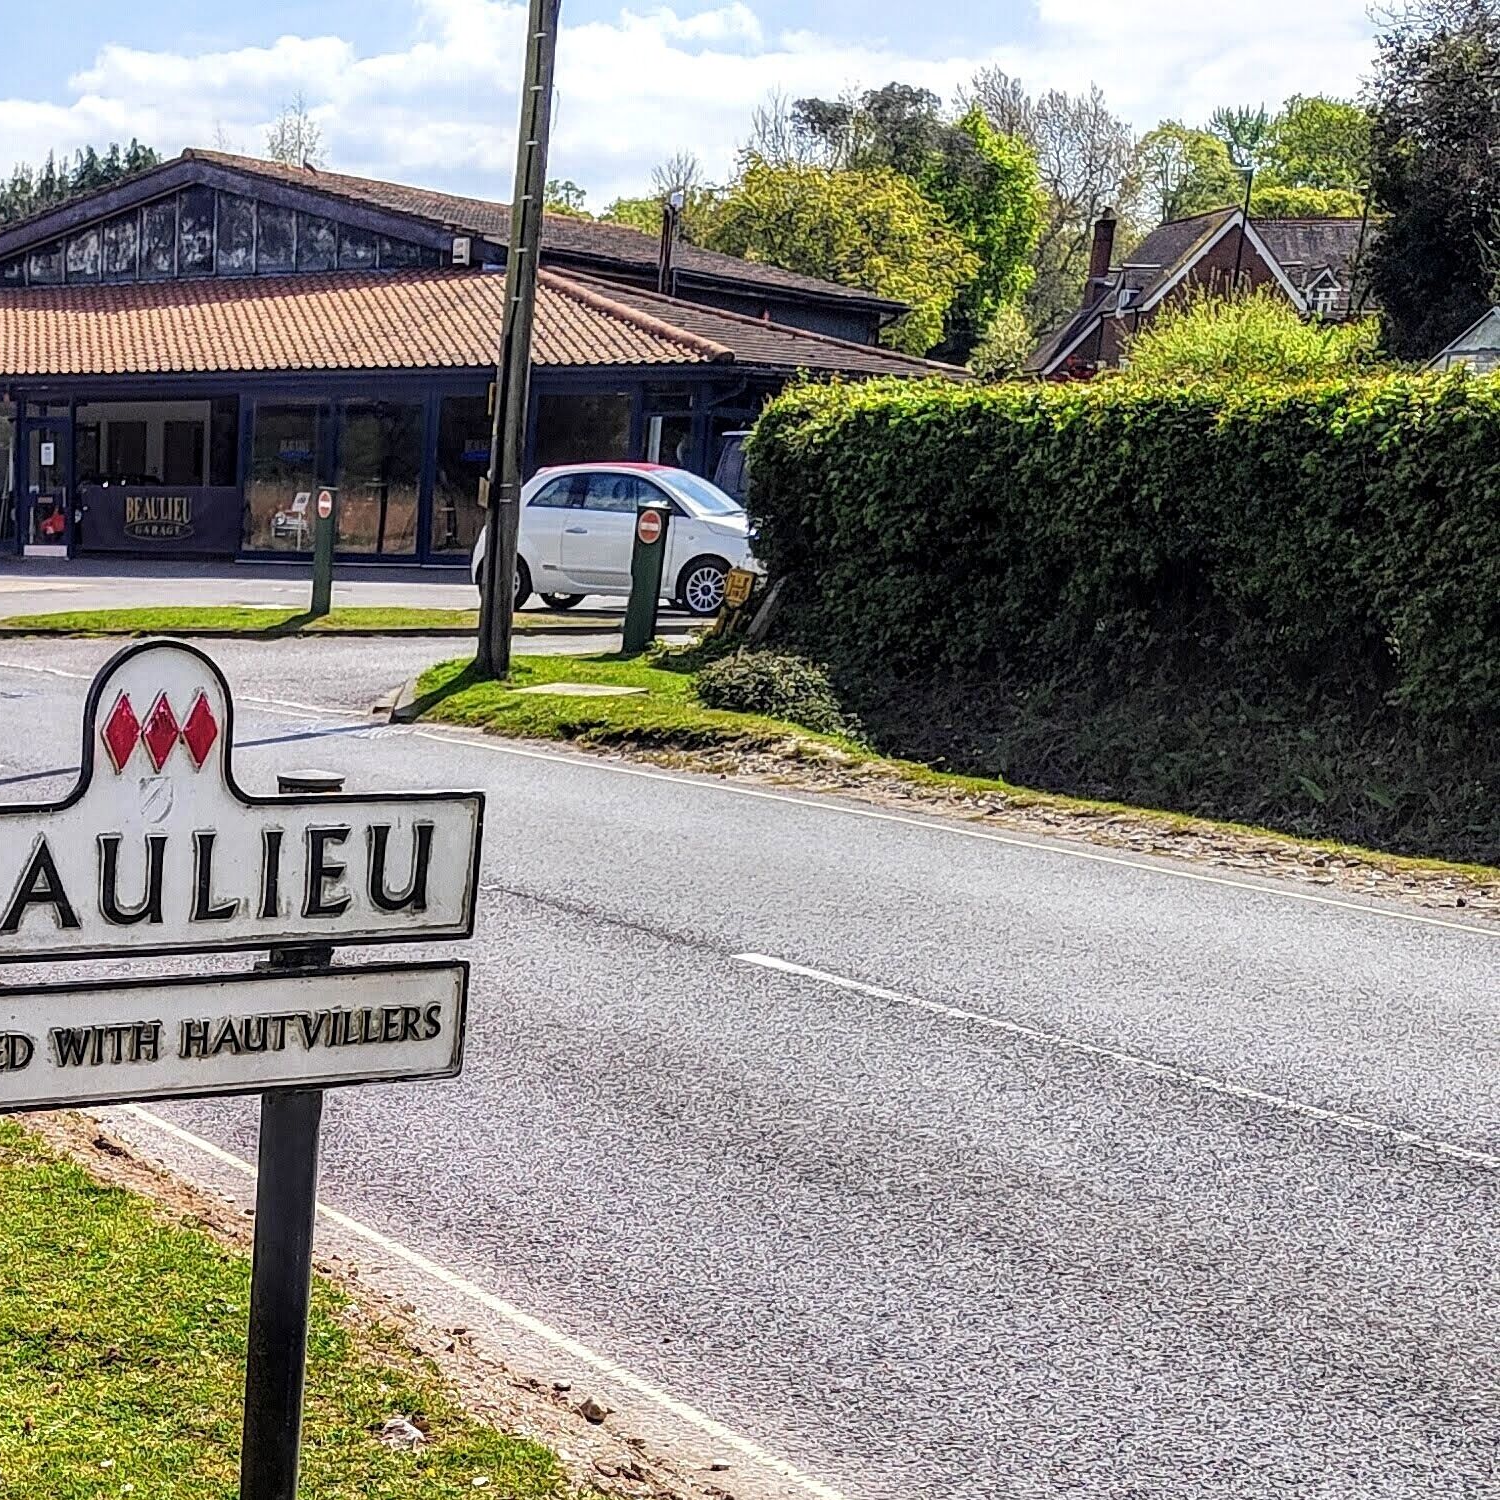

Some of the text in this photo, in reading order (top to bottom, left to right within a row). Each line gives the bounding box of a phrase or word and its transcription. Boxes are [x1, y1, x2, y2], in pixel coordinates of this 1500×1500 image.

[125, 496, 192, 524] BEAULIEU
[51, 1020, 162, 1067] WITH
[181, 1001, 442, 1058] HAUTVILLERS
